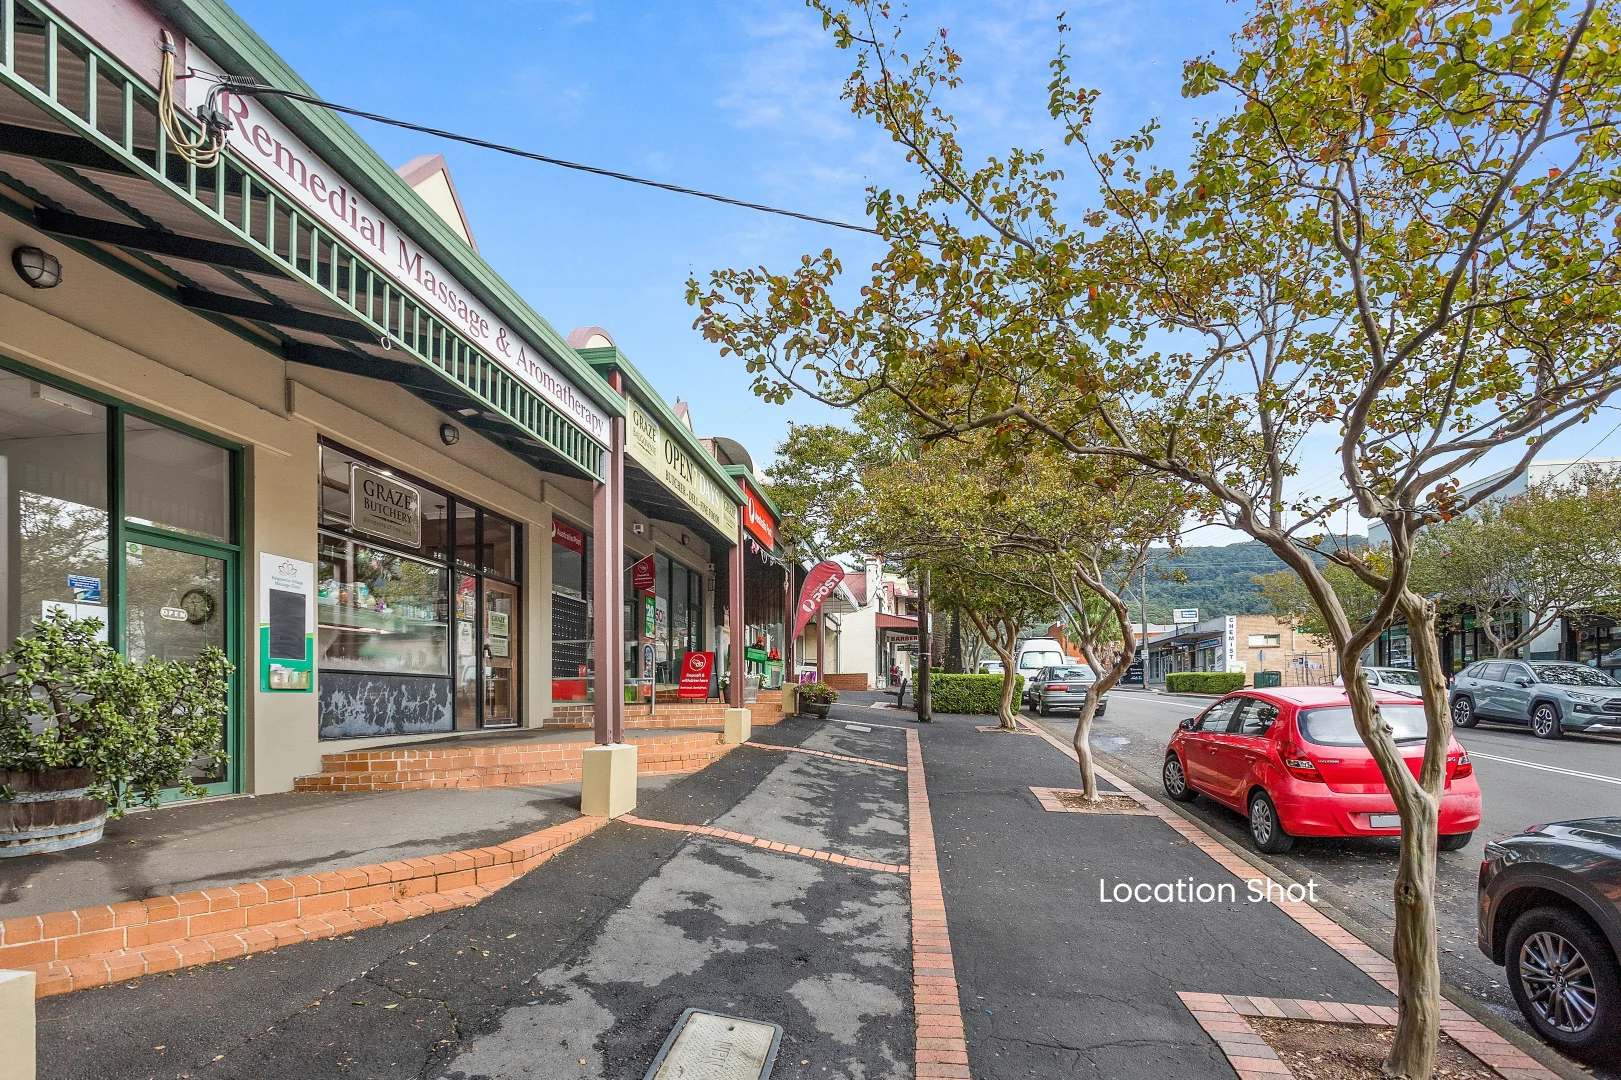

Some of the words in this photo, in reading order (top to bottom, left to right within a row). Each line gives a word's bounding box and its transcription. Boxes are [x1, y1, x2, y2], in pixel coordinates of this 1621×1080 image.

[220, 88, 386, 255] Remedial
[397, 236, 489, 338] Massage
[495, 327, 511, 357] &
[516, 346, 604, 437] Aromatherapy
[633, 410, 656, 443] GRAZE
[665, 439, 693, 485] OPEN
[693, 467, 698, 489] 7
[699, 472, 720, 509] DAYS
[363, 479, 411, 511] GRAZE
[364, 497, 412, 523] BUTCHERY
[557, 528, 574, 542] Australia
[573, 536, 581, 546] Post
[812, 573, 840, 603] POST
[162, 609, 186, 618] OPEN
